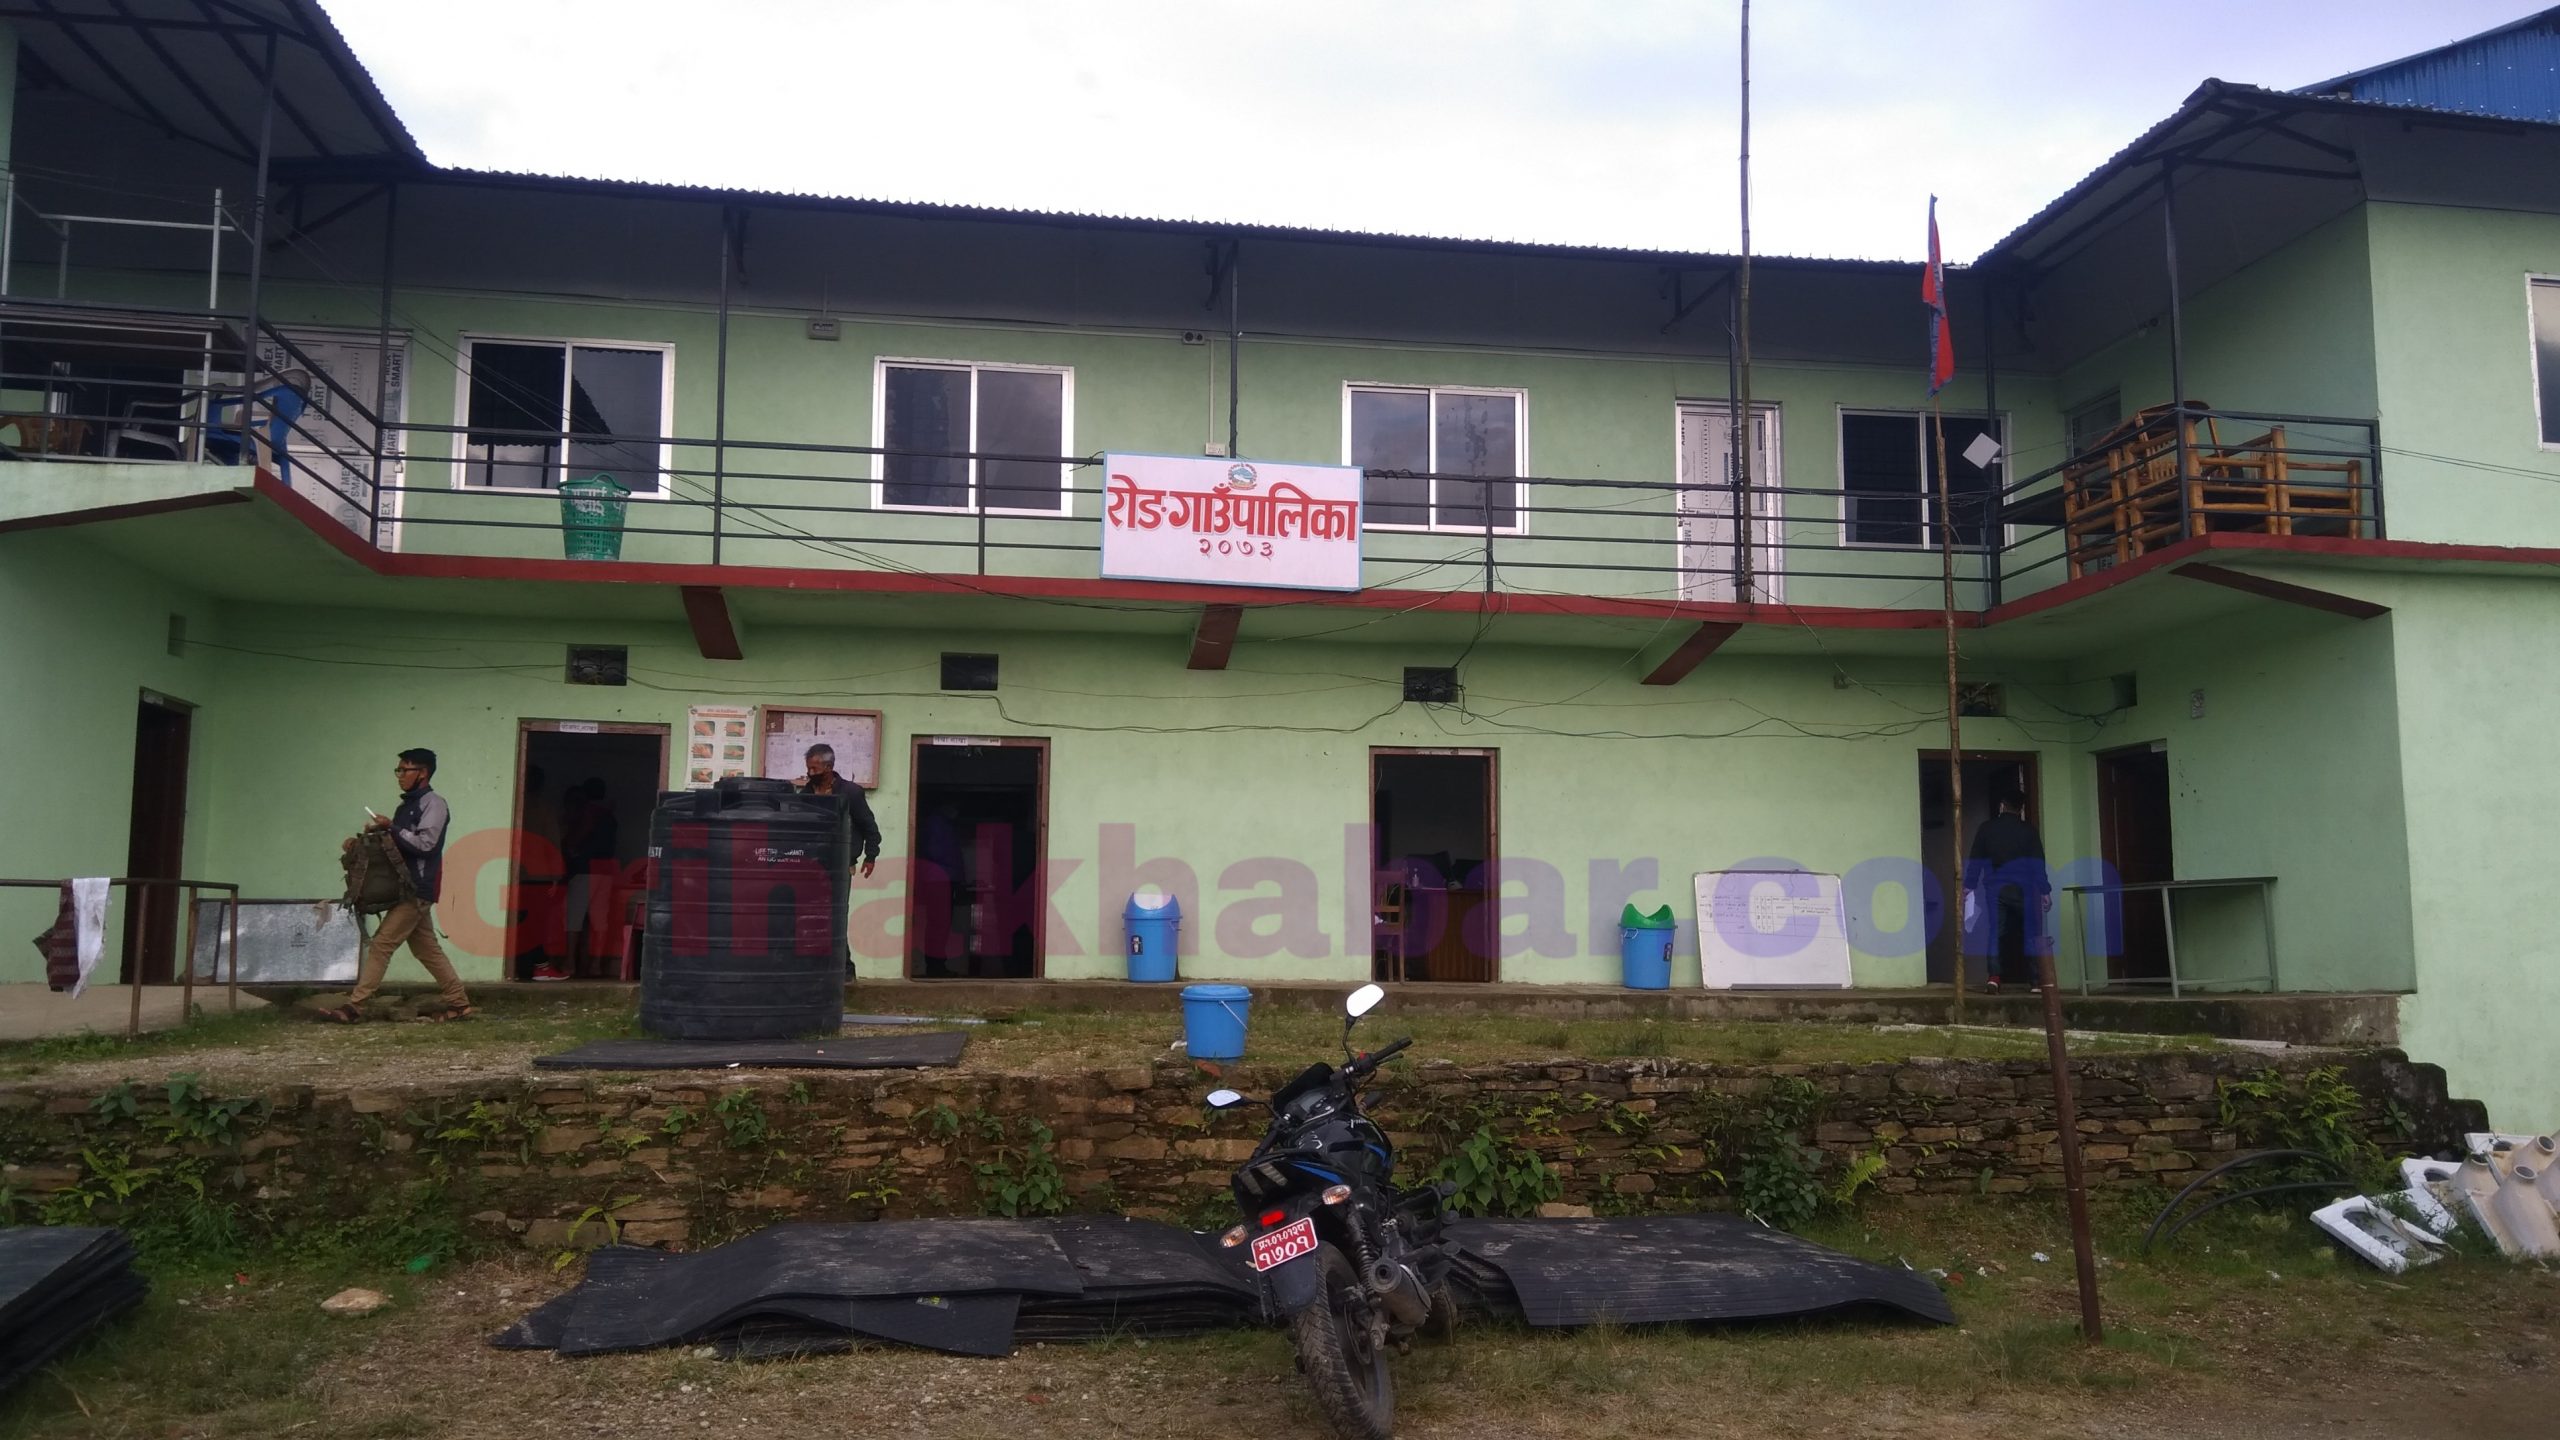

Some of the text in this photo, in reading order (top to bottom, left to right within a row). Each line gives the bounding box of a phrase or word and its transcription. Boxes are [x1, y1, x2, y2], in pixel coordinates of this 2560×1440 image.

[274, 345, 284, 371] MART
[391, 353, 401, 387] SMART
[313, 385, 324, 421] SART
[351, 462, 361, 497] SMAT
[1199, 538, 1273, 561] २०७३
[1259, 1235, 1310, 1266] १७०१
